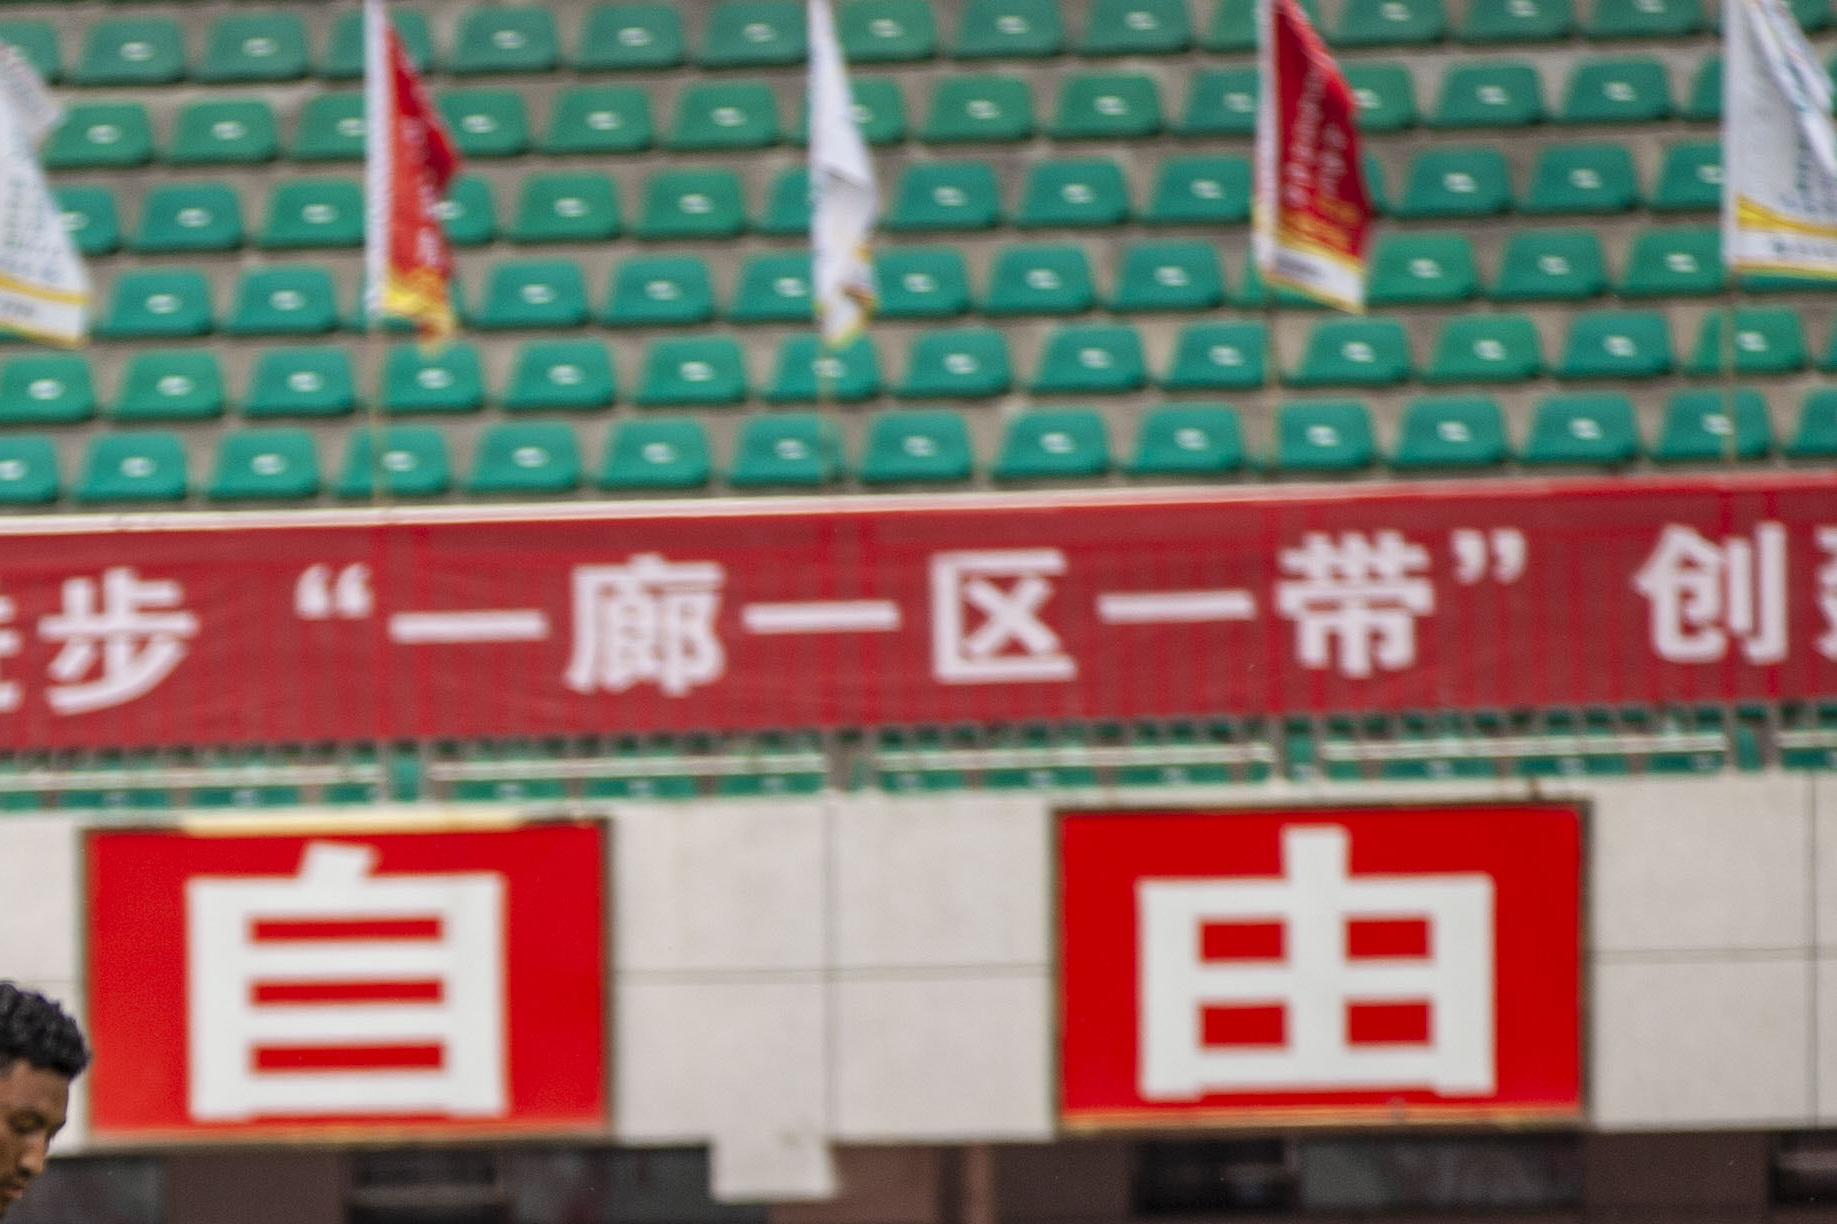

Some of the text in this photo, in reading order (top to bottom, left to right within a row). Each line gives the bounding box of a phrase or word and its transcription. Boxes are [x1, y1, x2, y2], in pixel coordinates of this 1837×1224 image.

[1630, 521, 1837, 666] 创
[184, 841, 509, 1121] 自
[1135, 824, 1496, 1100] 由
